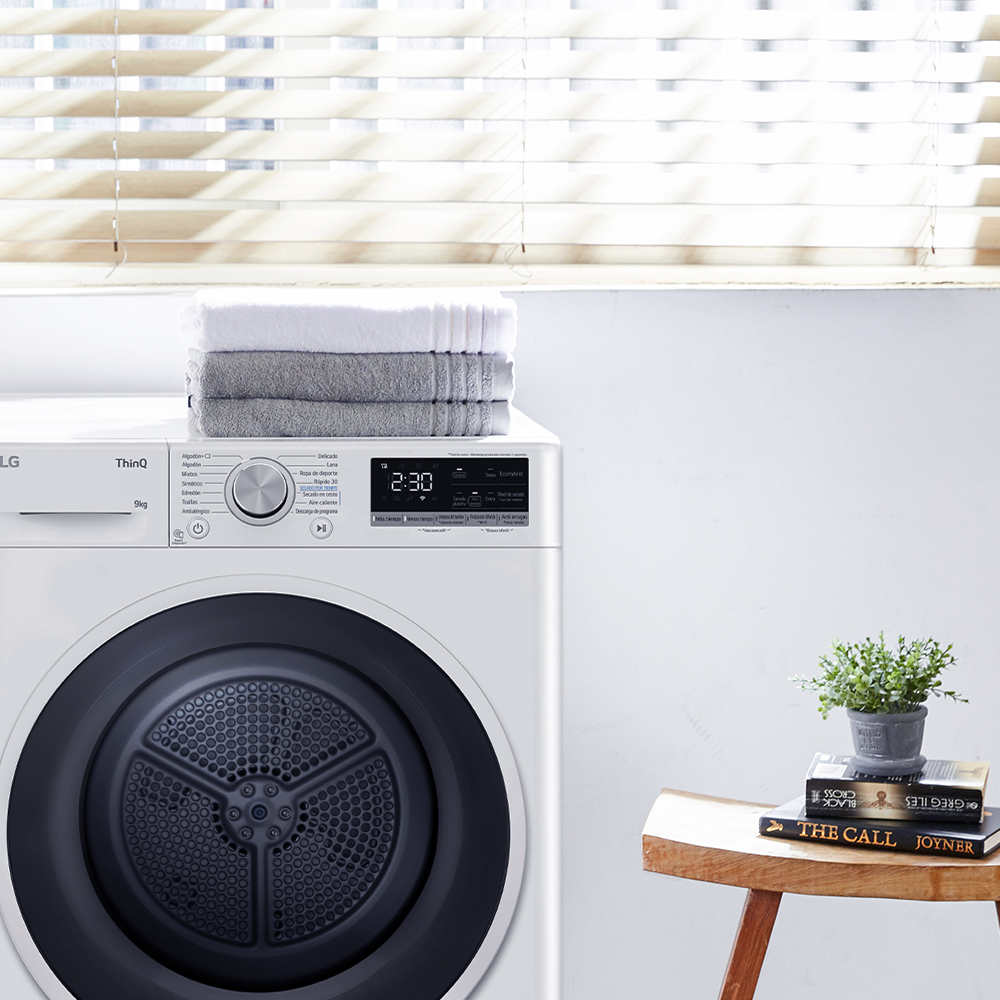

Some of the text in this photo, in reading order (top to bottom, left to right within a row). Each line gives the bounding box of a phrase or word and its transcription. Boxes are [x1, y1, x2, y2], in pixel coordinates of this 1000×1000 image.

[0, 456, 20, 468] LG
[115, 458, 148, 469] ThinQ
[391, 472, 433, 492] 2:30
[134, 500, 148, 509] 9kg
[824, 788, 856, 798] CROSS
[823, 798, 856, 808] BLACK
[905, 796, 965, 809] GREG ILES
[797, 821, 975, 854] THE CALL JOYNER
